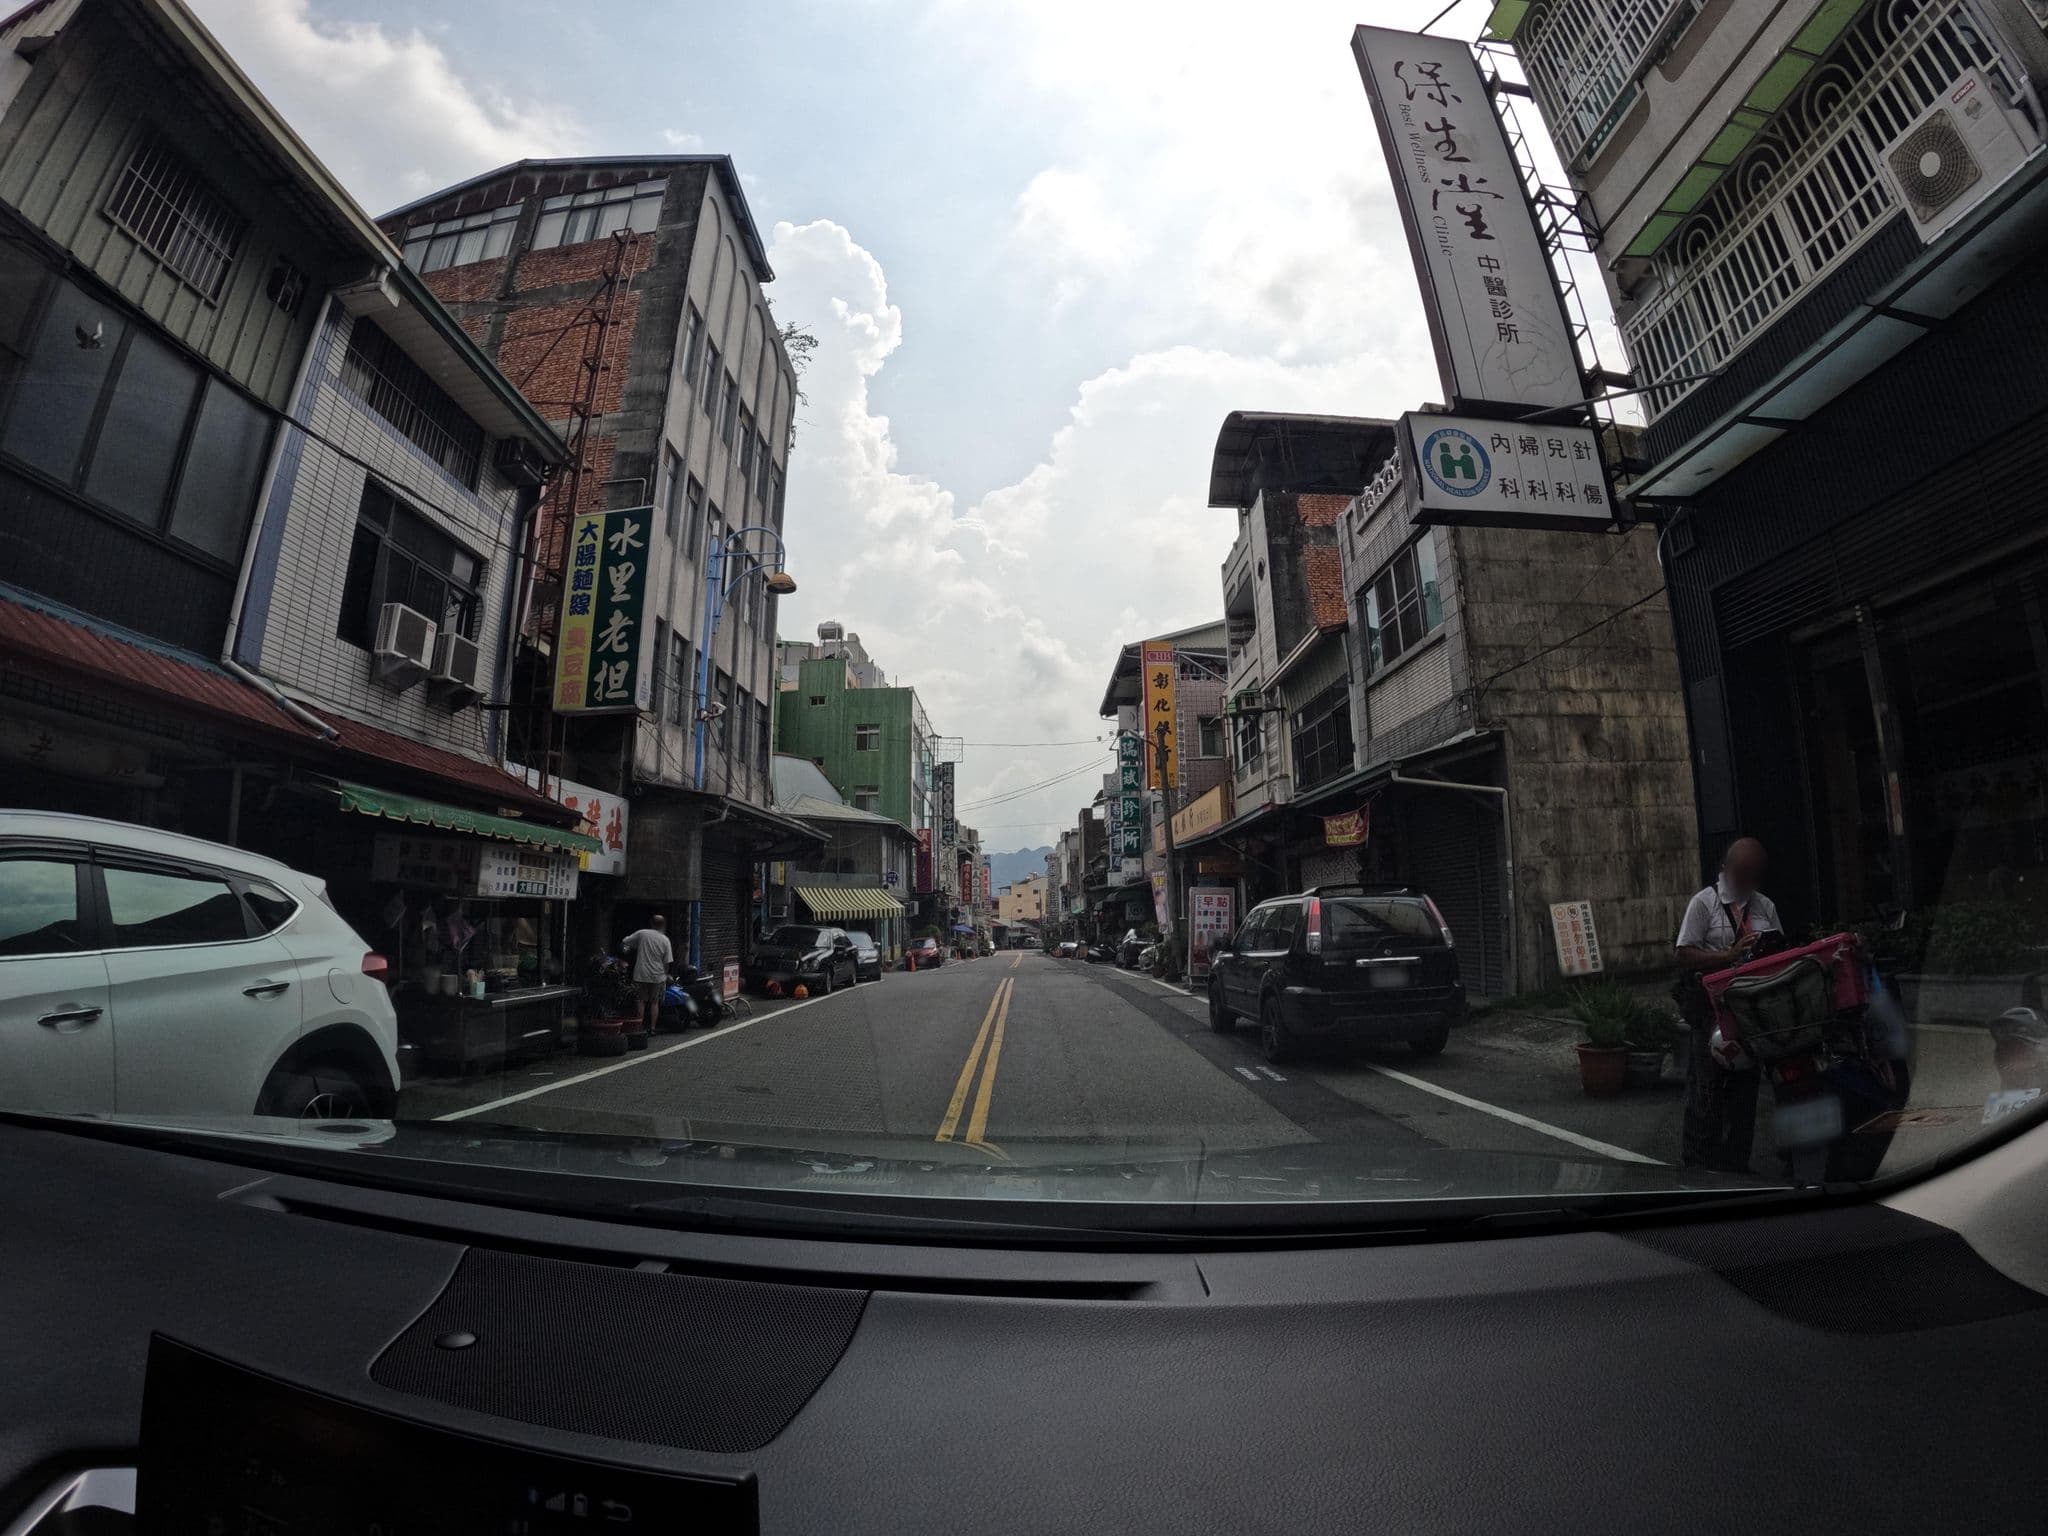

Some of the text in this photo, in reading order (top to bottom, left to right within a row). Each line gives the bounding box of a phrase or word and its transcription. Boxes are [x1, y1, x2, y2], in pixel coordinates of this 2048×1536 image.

[1954, 81, 1975, 103] HITACHI
[1395, 60, 1504, 241] 保生堂
[1397, 102, 1453, 257] Best Wellness Clinic
[1477, 254, 1520, 345] 中醫診所
[568, 520, 600, 616] 大腸麵線
[1147, 651, 1173, 662] CHB
